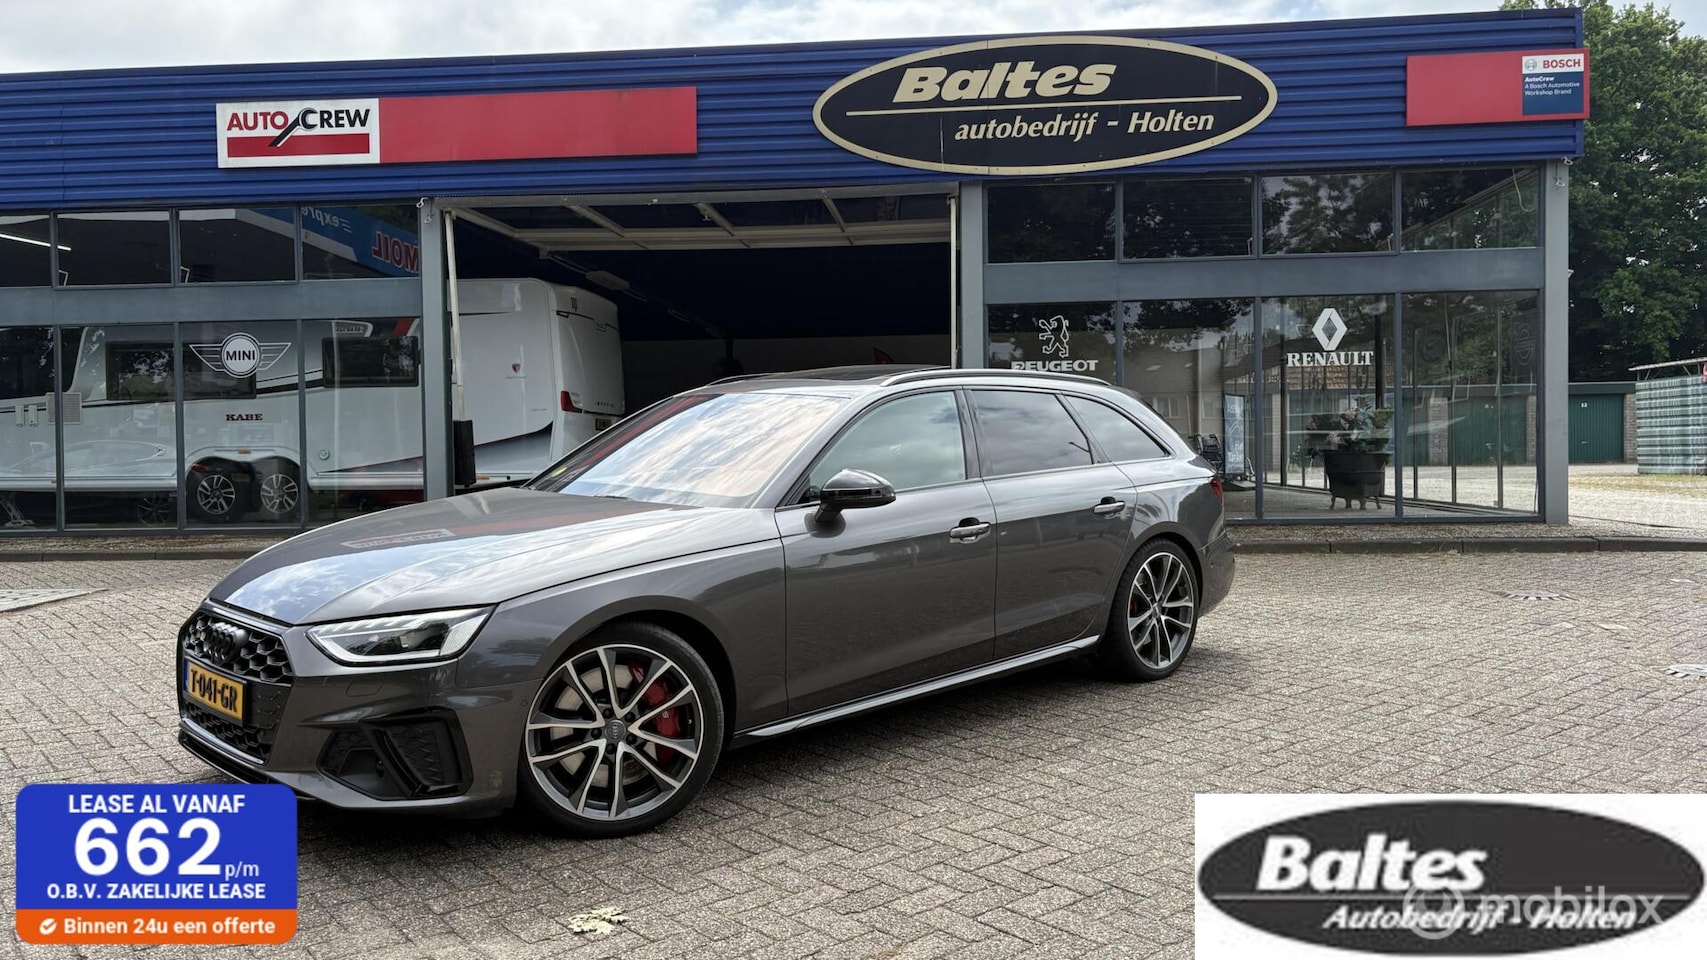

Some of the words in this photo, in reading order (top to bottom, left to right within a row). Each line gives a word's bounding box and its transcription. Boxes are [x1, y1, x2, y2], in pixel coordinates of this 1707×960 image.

[1542, 58, 1581, 69] BOSCH
[892, 61, 1117, 103] Baltes
[954, 112, 1099, 142] autobedrijf
[1127, 109, 1215, 134] Holten
[226, 350, 256, 361] MINI
[1286, 351, 1374, 367] RENAULT
[1011, 360, 1099, 371] PEUGEOT
[226, 413, 264, 422] KABE
[190, 669, 238, 713] T-041-GR
